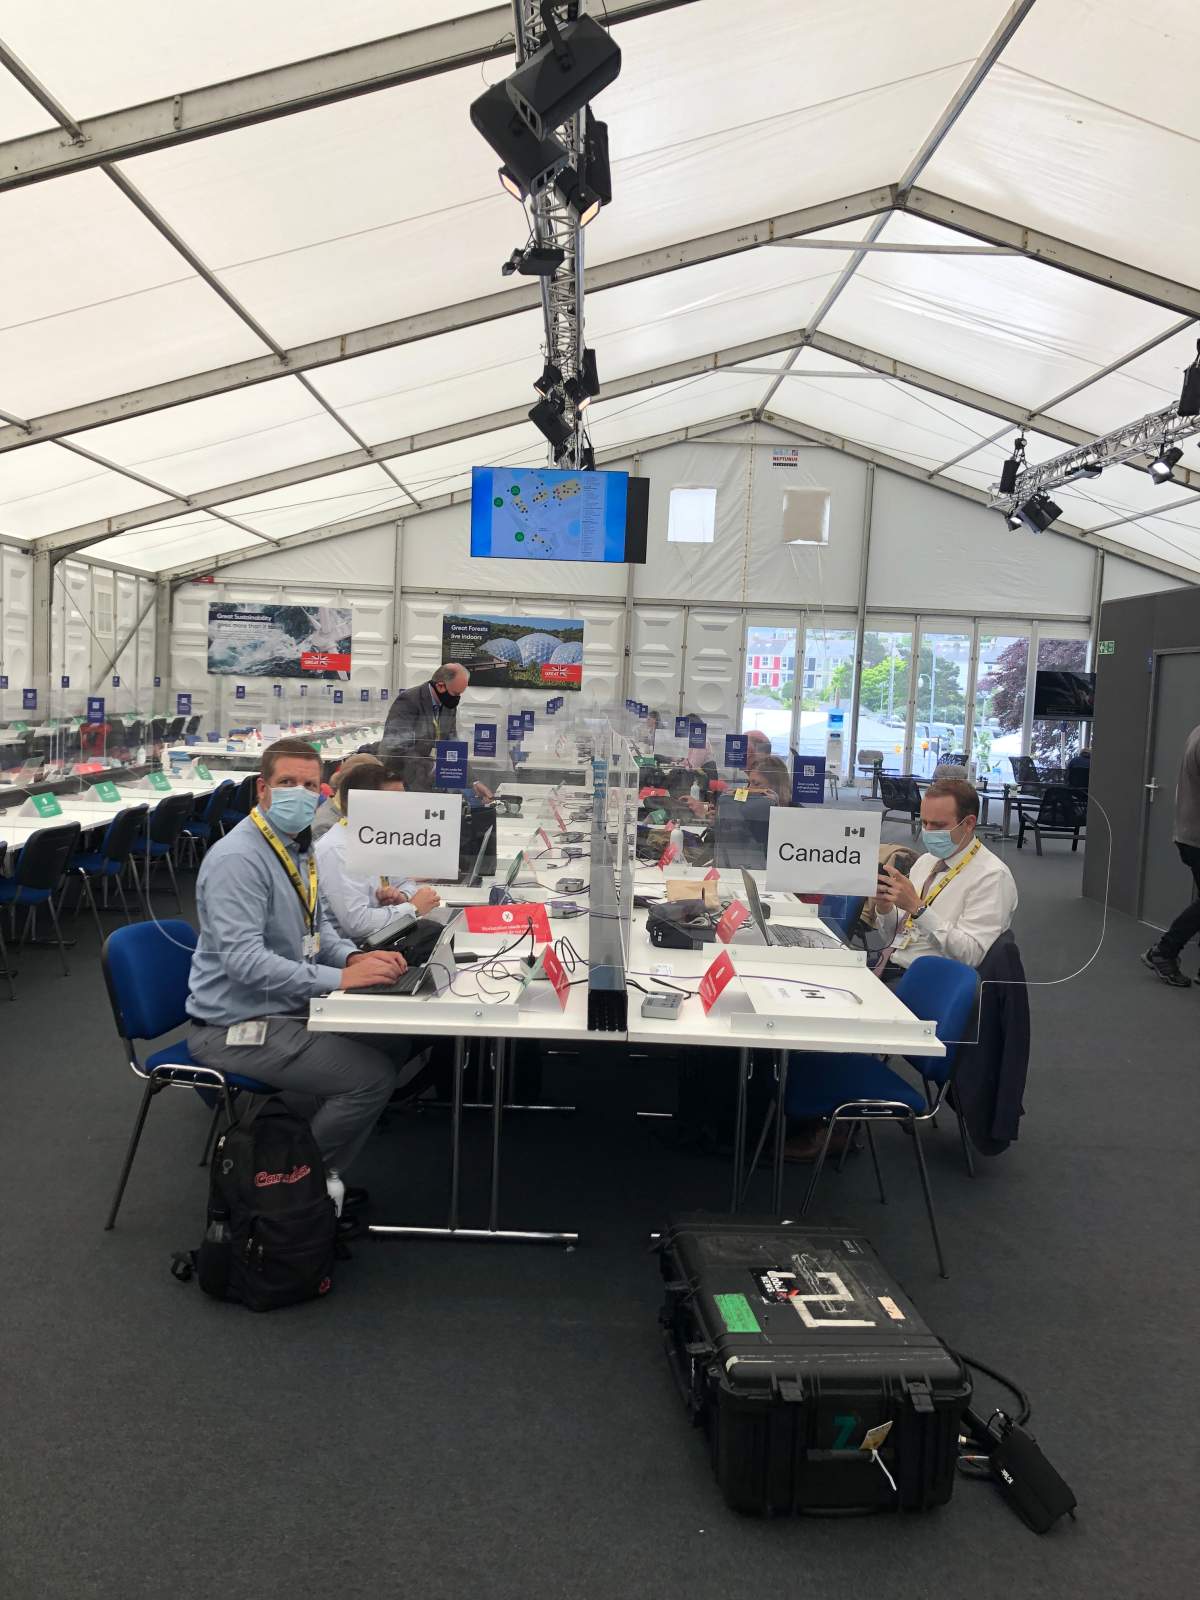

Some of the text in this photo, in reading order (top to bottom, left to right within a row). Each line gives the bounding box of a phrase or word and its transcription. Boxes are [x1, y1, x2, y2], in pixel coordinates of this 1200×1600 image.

[216, 612, 272, 622] Great Sustainability
[451, 624, 468, 632] Great
[358, 826, 441, 847] Canada
[778, 842, 861, 865] Canada
[760, 1276, 775, 1293] NEWS
